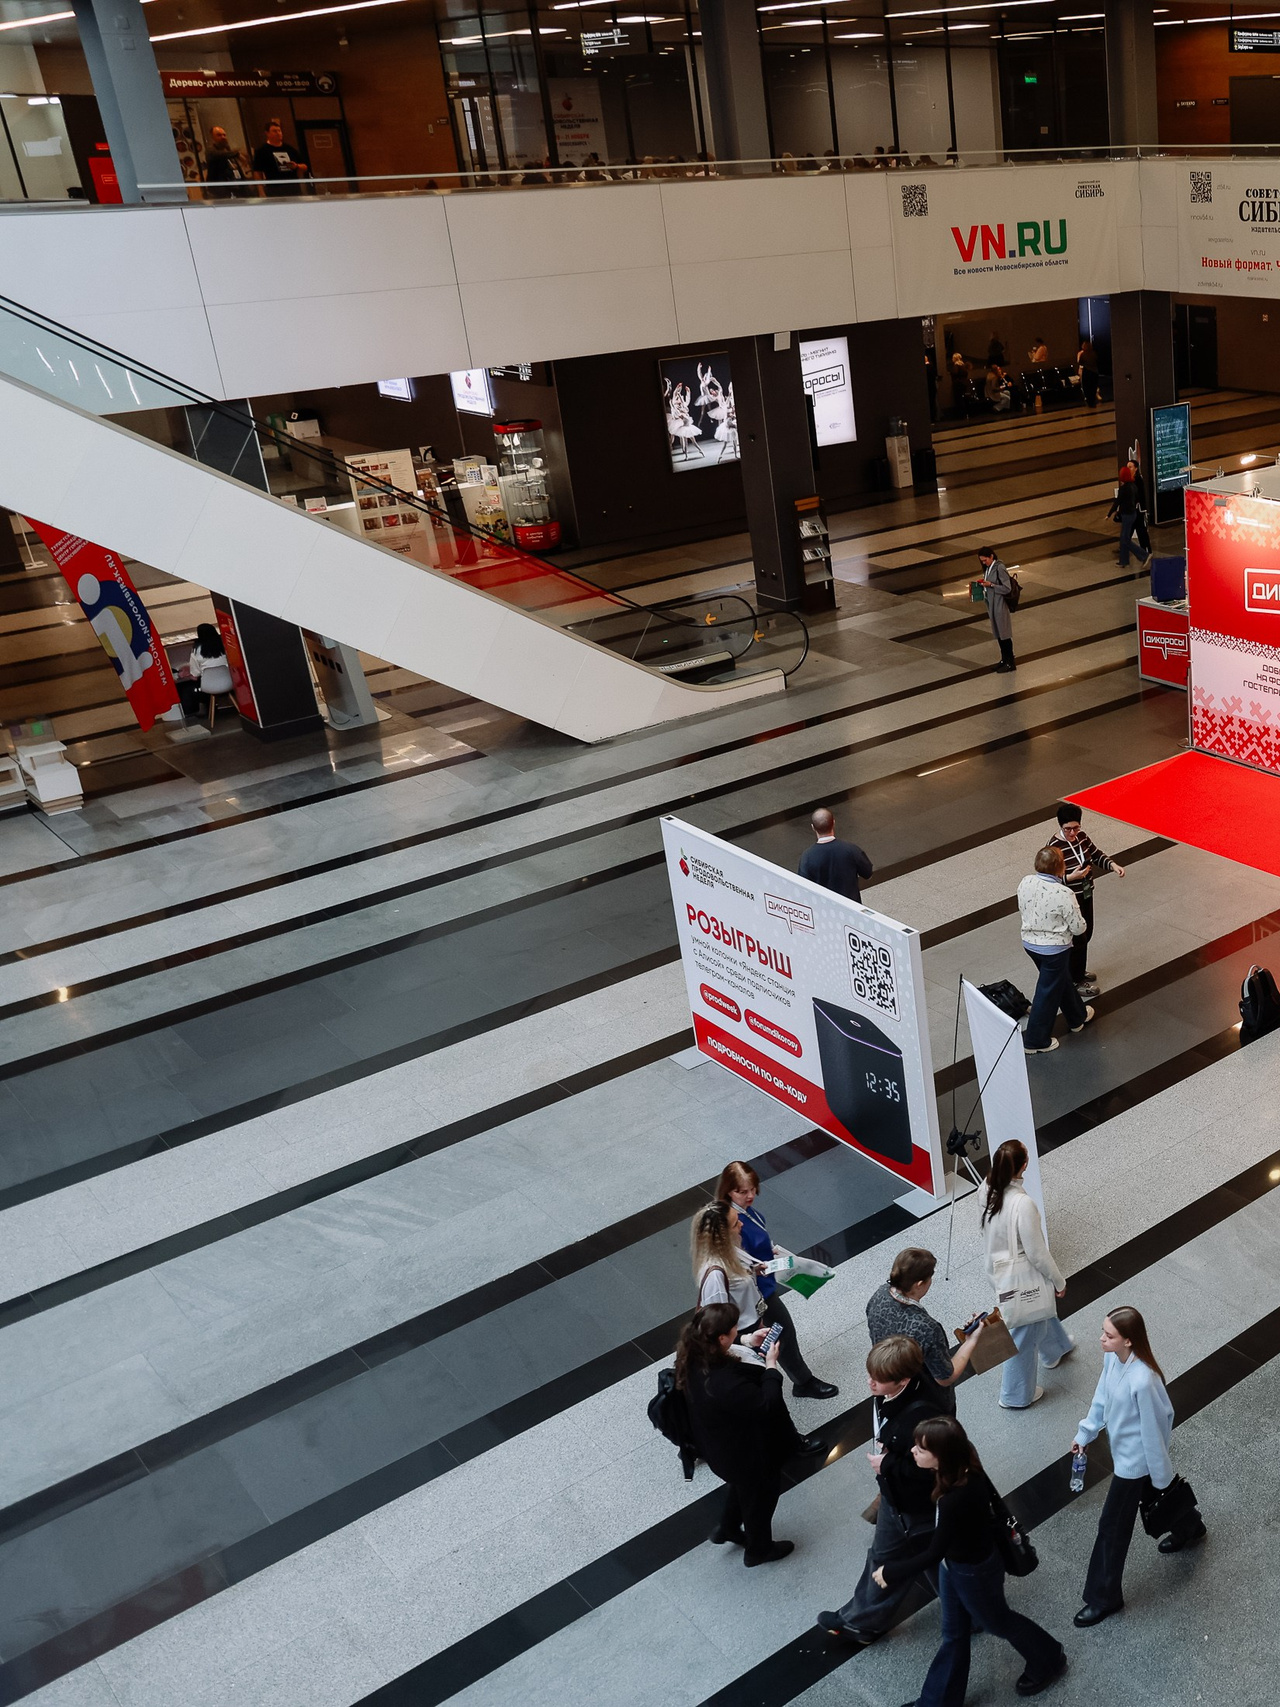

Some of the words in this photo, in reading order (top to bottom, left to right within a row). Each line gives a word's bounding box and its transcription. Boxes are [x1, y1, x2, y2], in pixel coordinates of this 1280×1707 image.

[169, 78, 270, 88] Дерево-для-жизни.рф
[1075, 188, 1105, 199] СИБИРЬ
[951, 219, 1068, 263] VN.RU
[953, 268, 966, 276] Все
[967, 265, 994, 275] новости
[994, 259, 1044, 272] Новосибирской
[1044, 258, 1069, 268] области
[1201, 257, 1232, 269] Новый
[1234, 258, 1273, 272] формат.
[803, 372, 841, 390] ОРОСЫ
[104, 554, 168, 686] WELCOME-NOVOSIBIRSK.RU
[1146, 635, 1185, 646] ДИКОРОСЫ
[1256, 673, 1268, 682] НА
[690, 856, 724, 878] СИБИРСКАЯ
[691, 864, 755, 901] ПРОДОВОЛЬСТВЕННАЯ
[692, 872, 715, 889] НЕДЕЛЯ
[768, 900, 811, 922] ДИКОРОСЫ
[686, 902, 793, 980] РОЗЫГРЫШ
[691, 935, 711, 952] умной
[711, 947, 738, 966] колонки
[767, 977, 796, 998] станция
[695, 960, 755, 1000] телеграм-каналов
[726, 966, 747, 983] среди
[747, 979, 791, 1008] подписчиков
[703, 990, 739, 1016] @prodweek
[707, 1035, 761, 1076] ПОДРОБНОСТИ
[761, 1069, 772, 1083] ПО
[773, 1076, 807, 1104] QR-КОДУ
[865, 1072, 901, 1103] 12:35
